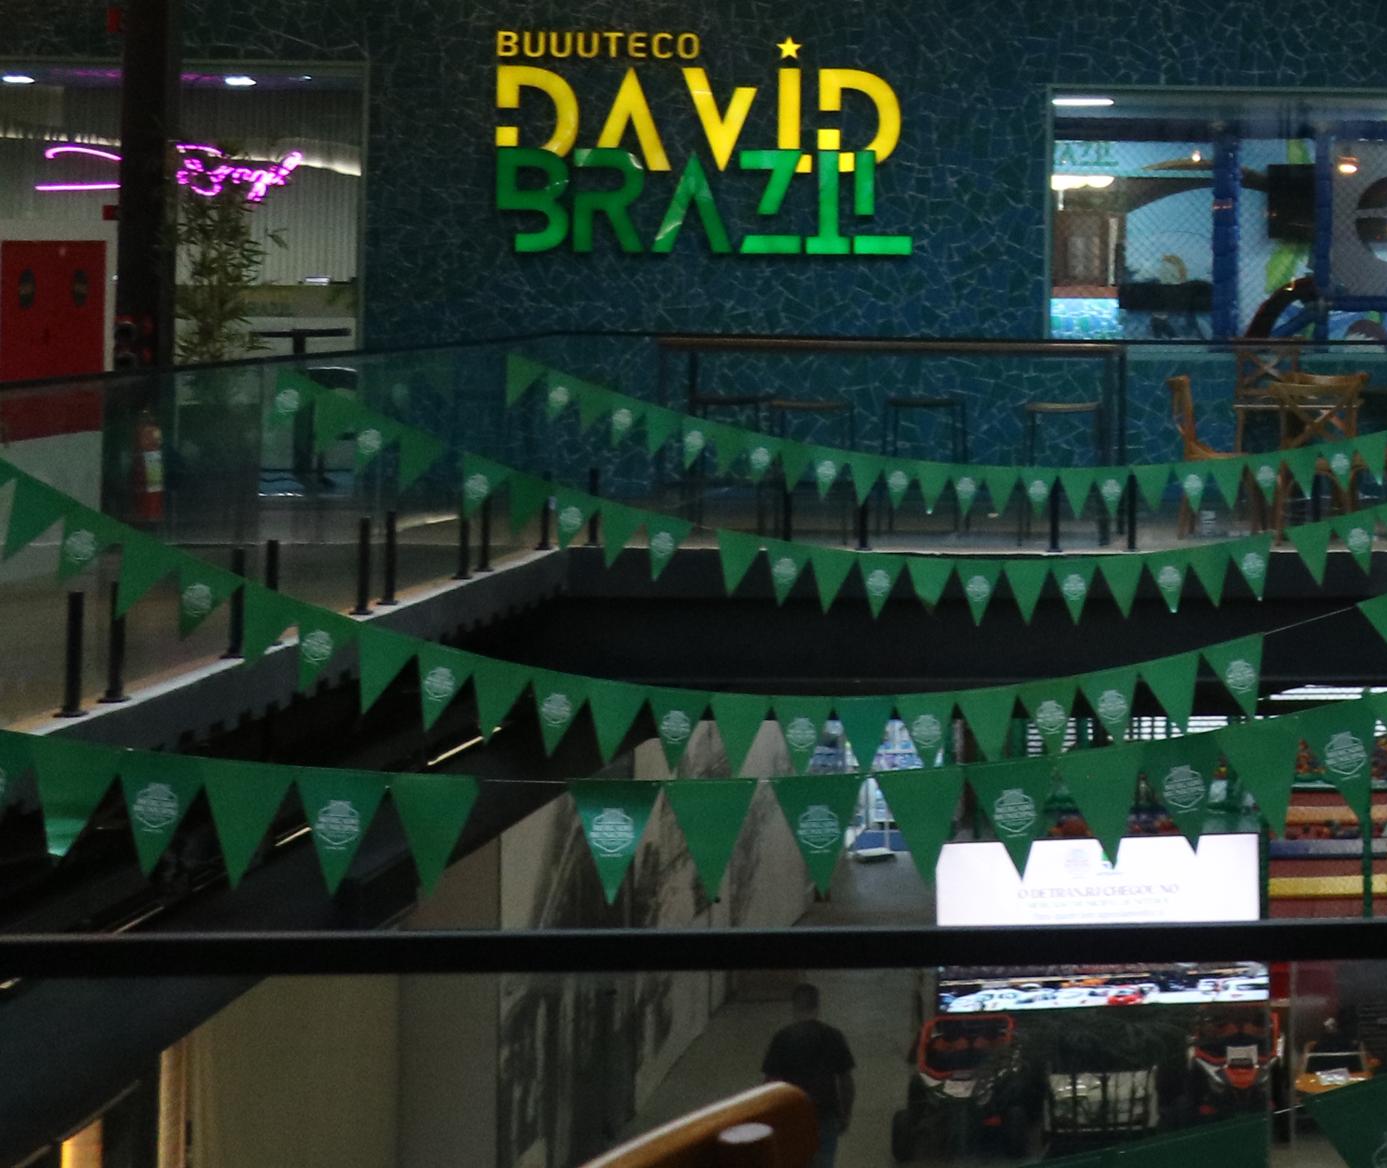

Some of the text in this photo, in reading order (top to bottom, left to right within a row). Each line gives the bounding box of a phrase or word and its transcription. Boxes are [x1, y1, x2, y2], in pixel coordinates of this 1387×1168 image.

[496, 29, 701, 61] BUUUTECO
[495, 64, 902, 173] DAVID
[495, 148, 914, 256] BRAZIL
